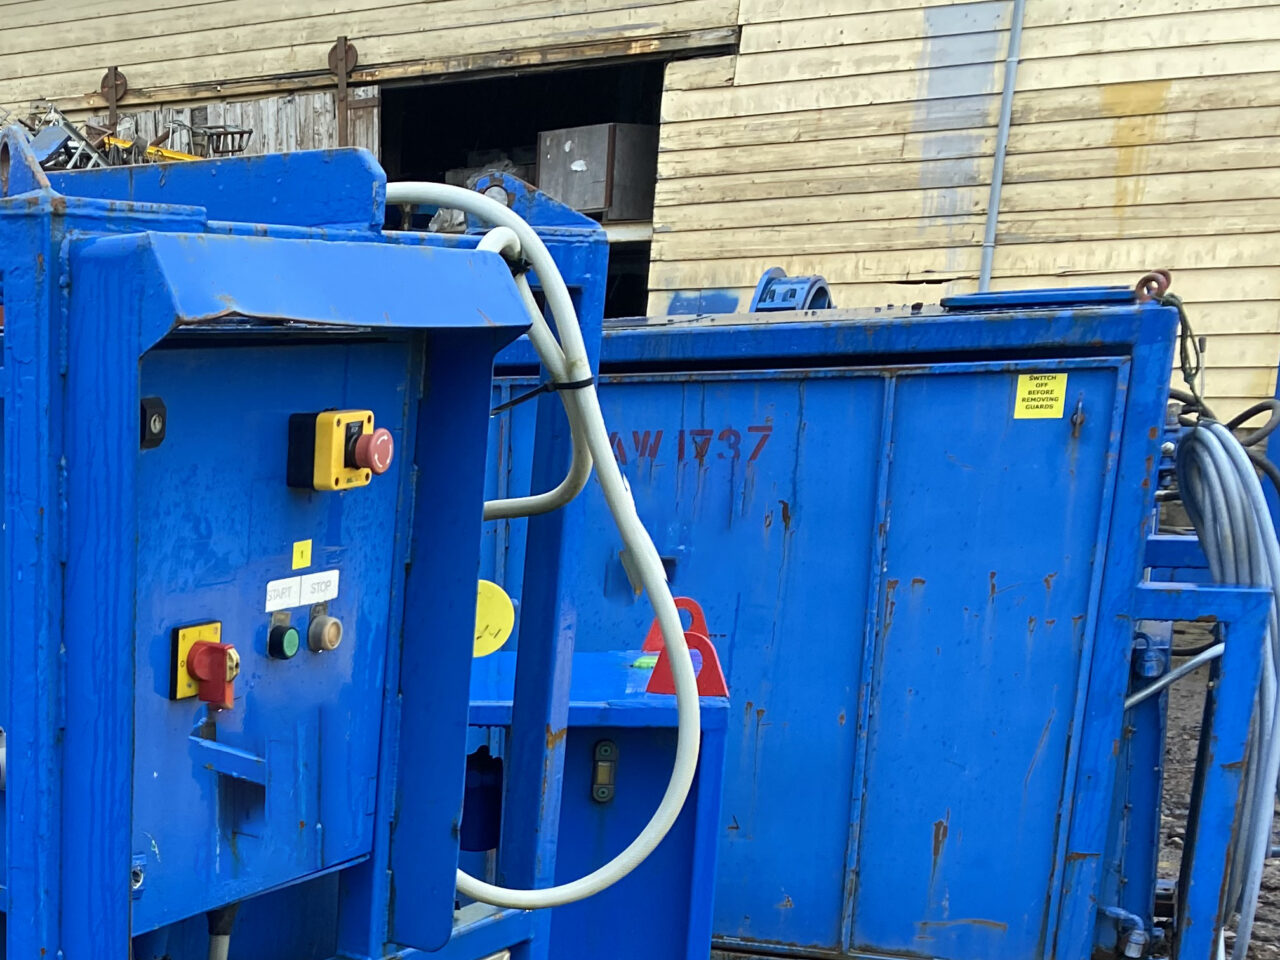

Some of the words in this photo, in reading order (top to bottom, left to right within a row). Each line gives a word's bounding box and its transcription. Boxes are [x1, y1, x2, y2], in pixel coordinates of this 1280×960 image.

[677, 425, 773, 462] 1737
[267, 586, 293, 602] START
[310, 580, 332, 594] STOP
